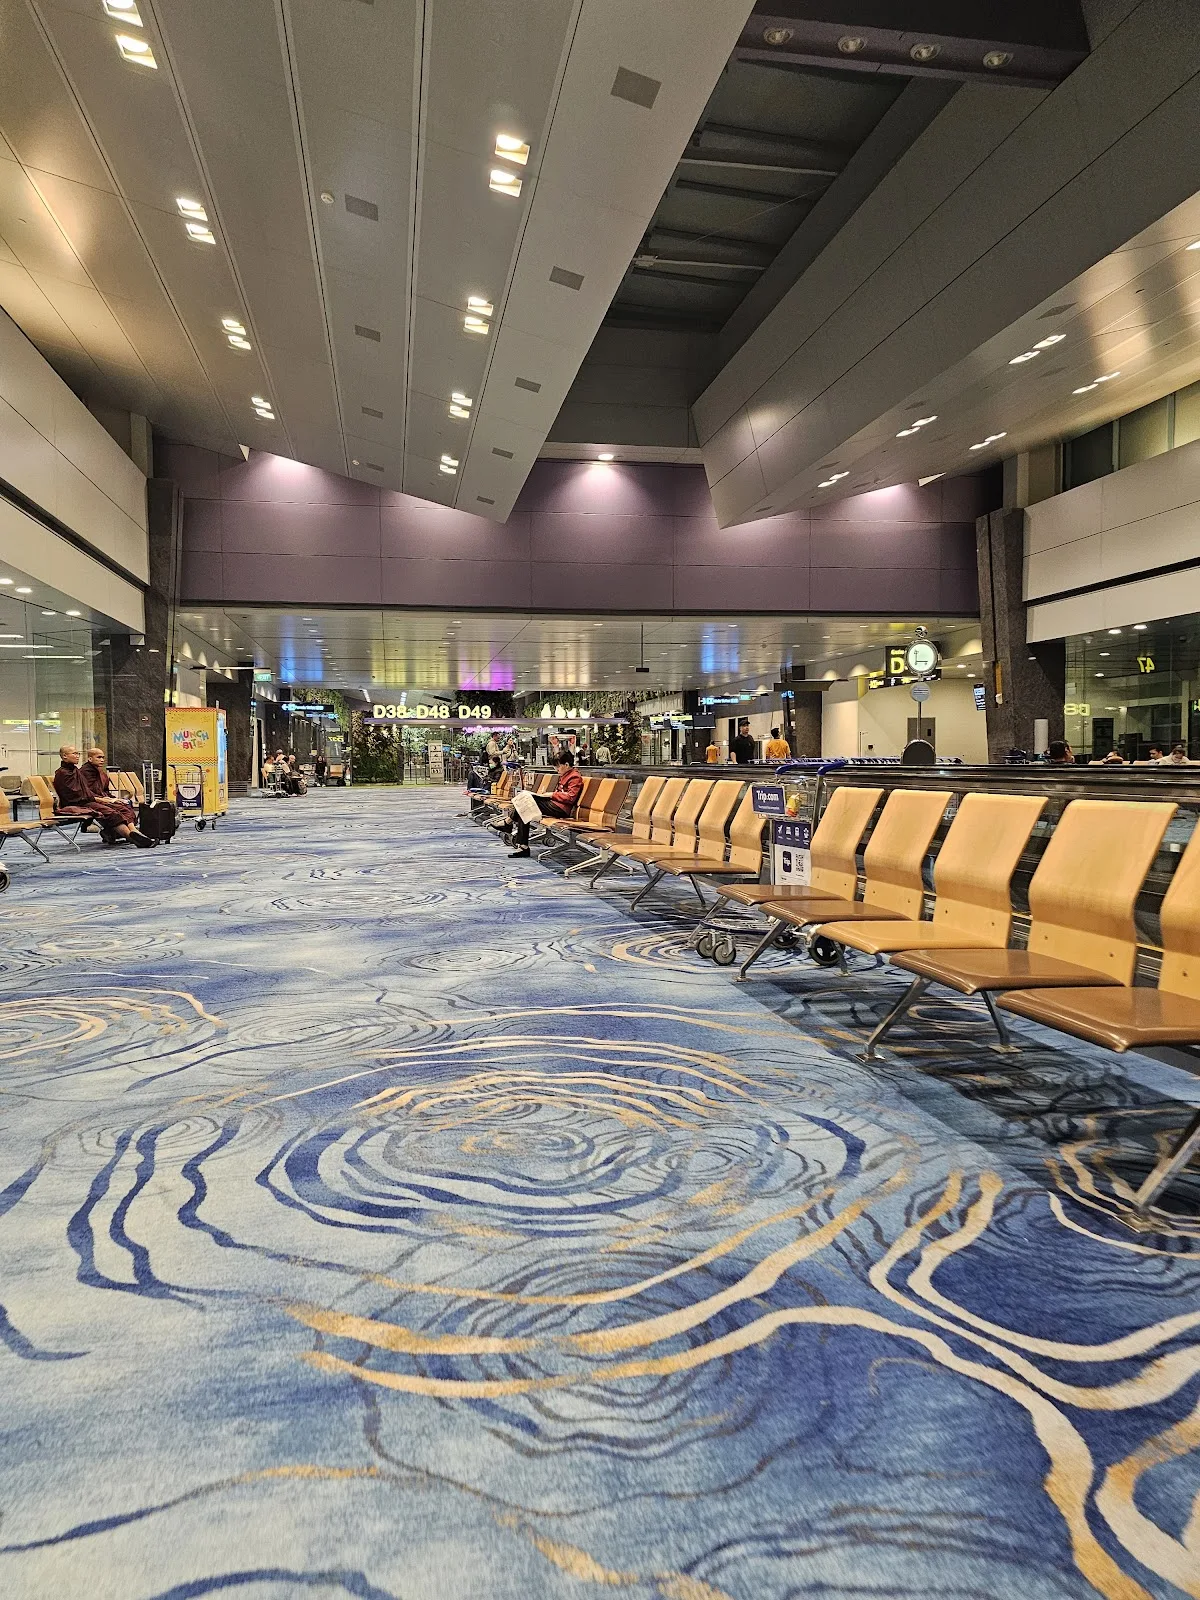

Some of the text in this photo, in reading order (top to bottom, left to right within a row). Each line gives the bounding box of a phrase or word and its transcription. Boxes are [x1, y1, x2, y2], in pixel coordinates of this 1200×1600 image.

[373, 705, 492, 719] D38 D48 D49
[173, 730, 209, 743] MUNCH
[183, 739, 203, 750] BITE
[756, 790, 779, 803] Trip.com
